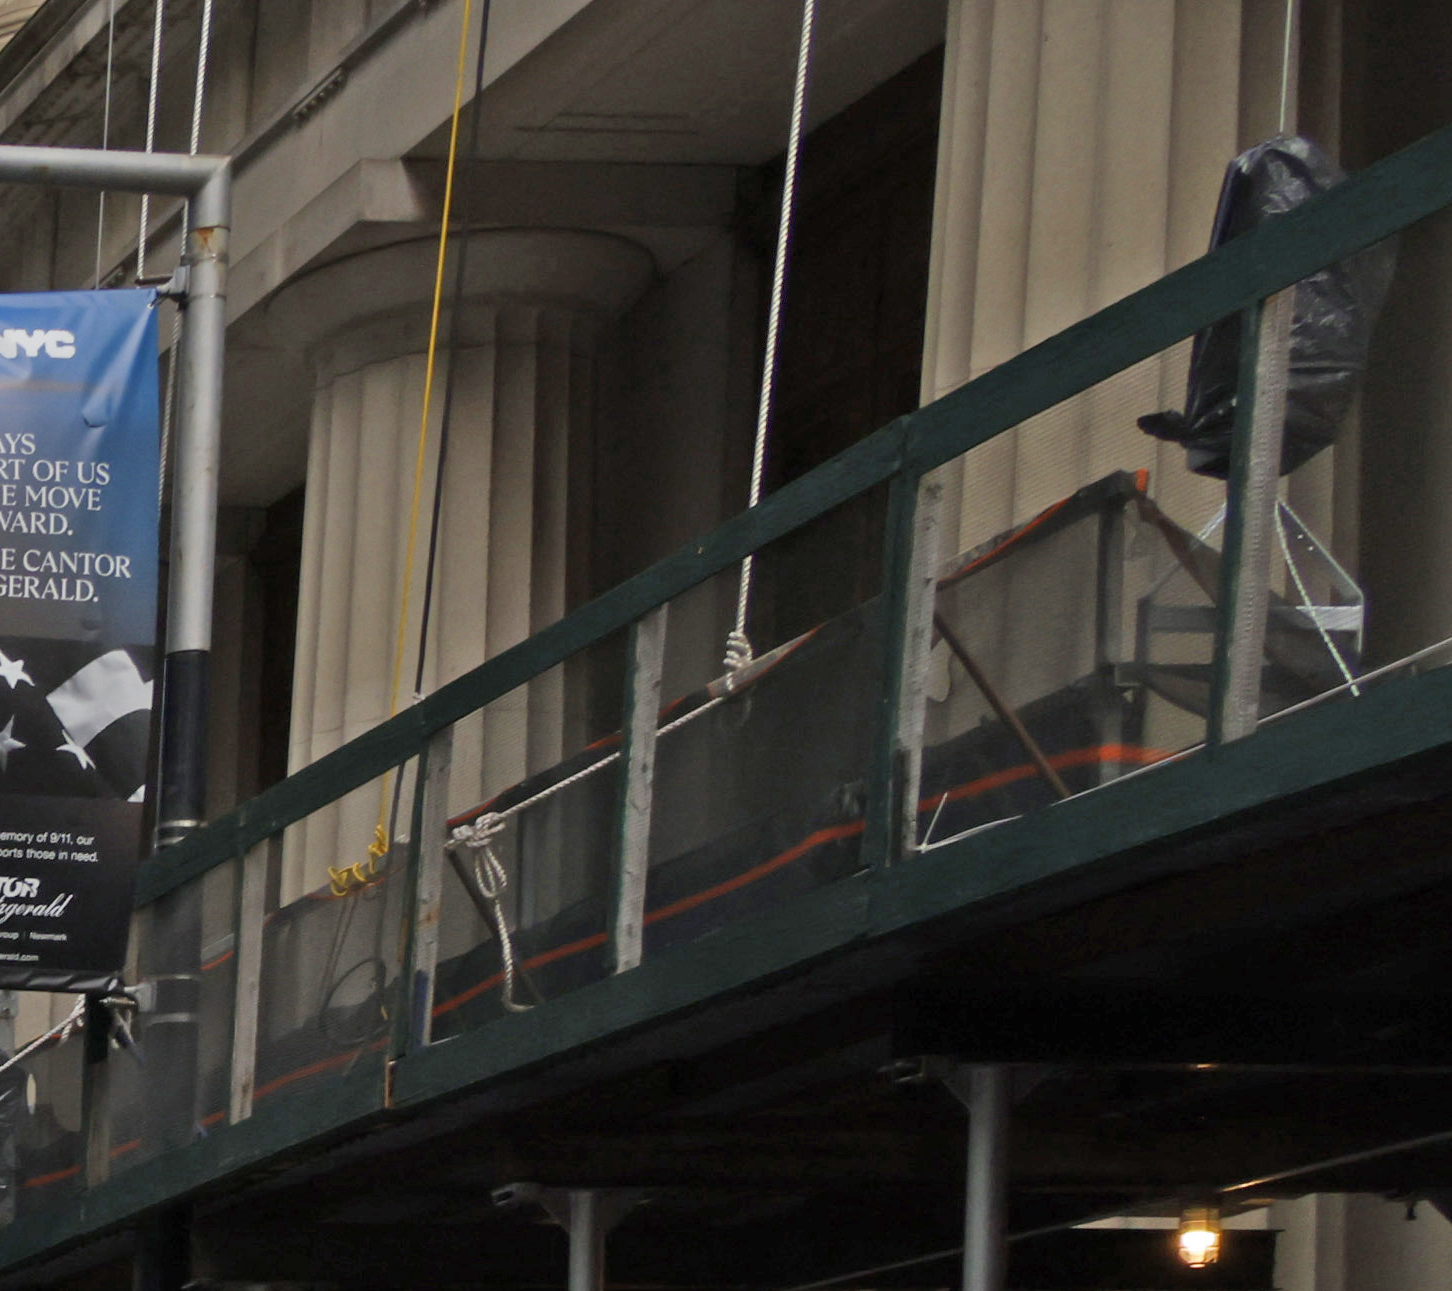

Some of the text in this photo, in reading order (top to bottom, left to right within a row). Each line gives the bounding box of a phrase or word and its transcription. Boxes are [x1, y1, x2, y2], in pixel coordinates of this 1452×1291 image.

[32, 460, 69, 482] OF
[77, 462, 110, 486] US
[25, 486, 102, 511] MOVE
[23, 550, 131, 578] CANTOR
[36, 832, 47, 843] of
[76, 836, 94, 845] our
[26, 848, 55, 860] those
[58, 850, 68, 861] in
[71, 852, 99, 863] need.
[29, 931, 67, 941] Newmark
